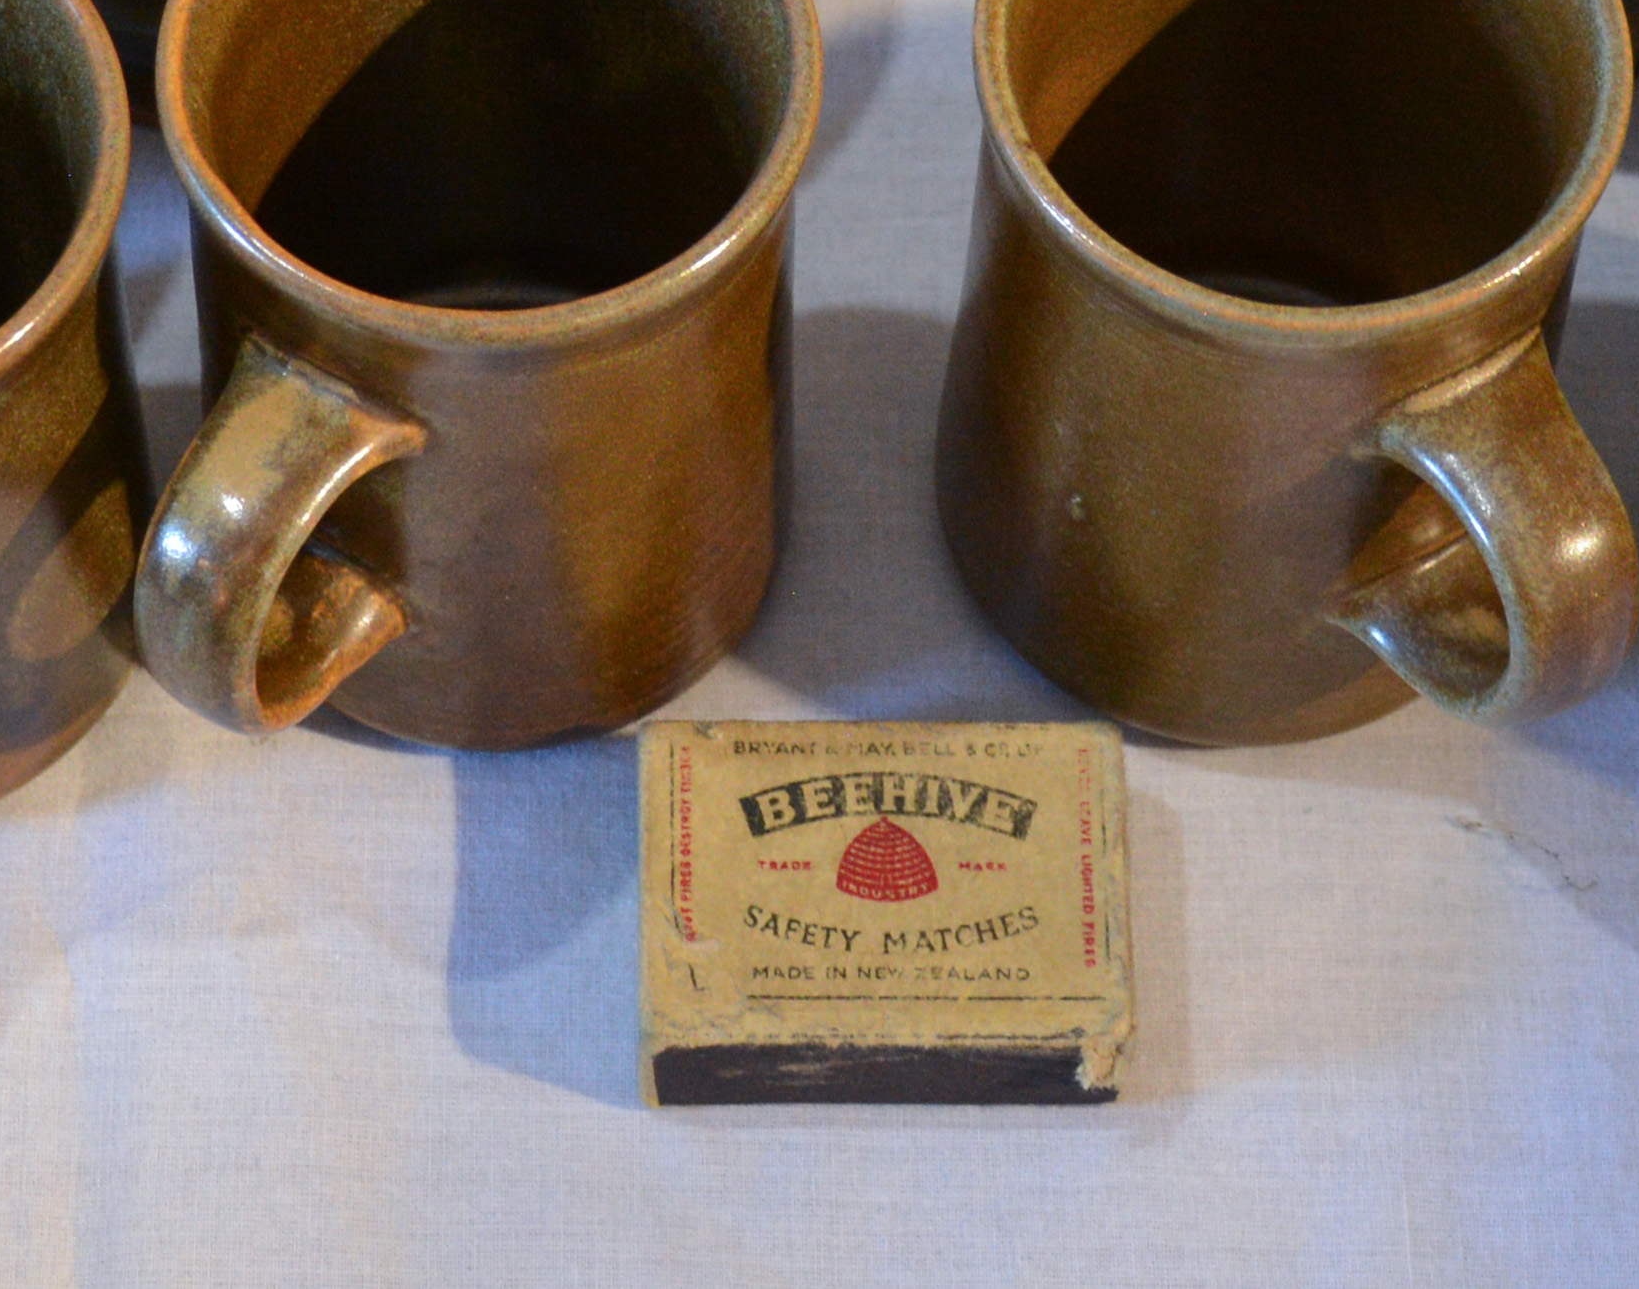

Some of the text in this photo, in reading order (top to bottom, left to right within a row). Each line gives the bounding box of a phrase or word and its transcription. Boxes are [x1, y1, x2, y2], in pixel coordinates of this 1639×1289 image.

[733, 740, 817, 755] BRYANT
[754, 773, 1021, 833] BEEHIVE
[758, 859, 1008, 872] TRADE MARK
[843, 879, 929, 899] INDUSTRY
[1081, 853, 1095, 915] LIGHTED
[743, 904, 1040, 955] SAFETY MATCHES
[1082, 921, 1097, 969] FIRES
[753, 966, 815, 981] MADE
[825, 966, 848, 981] IN
